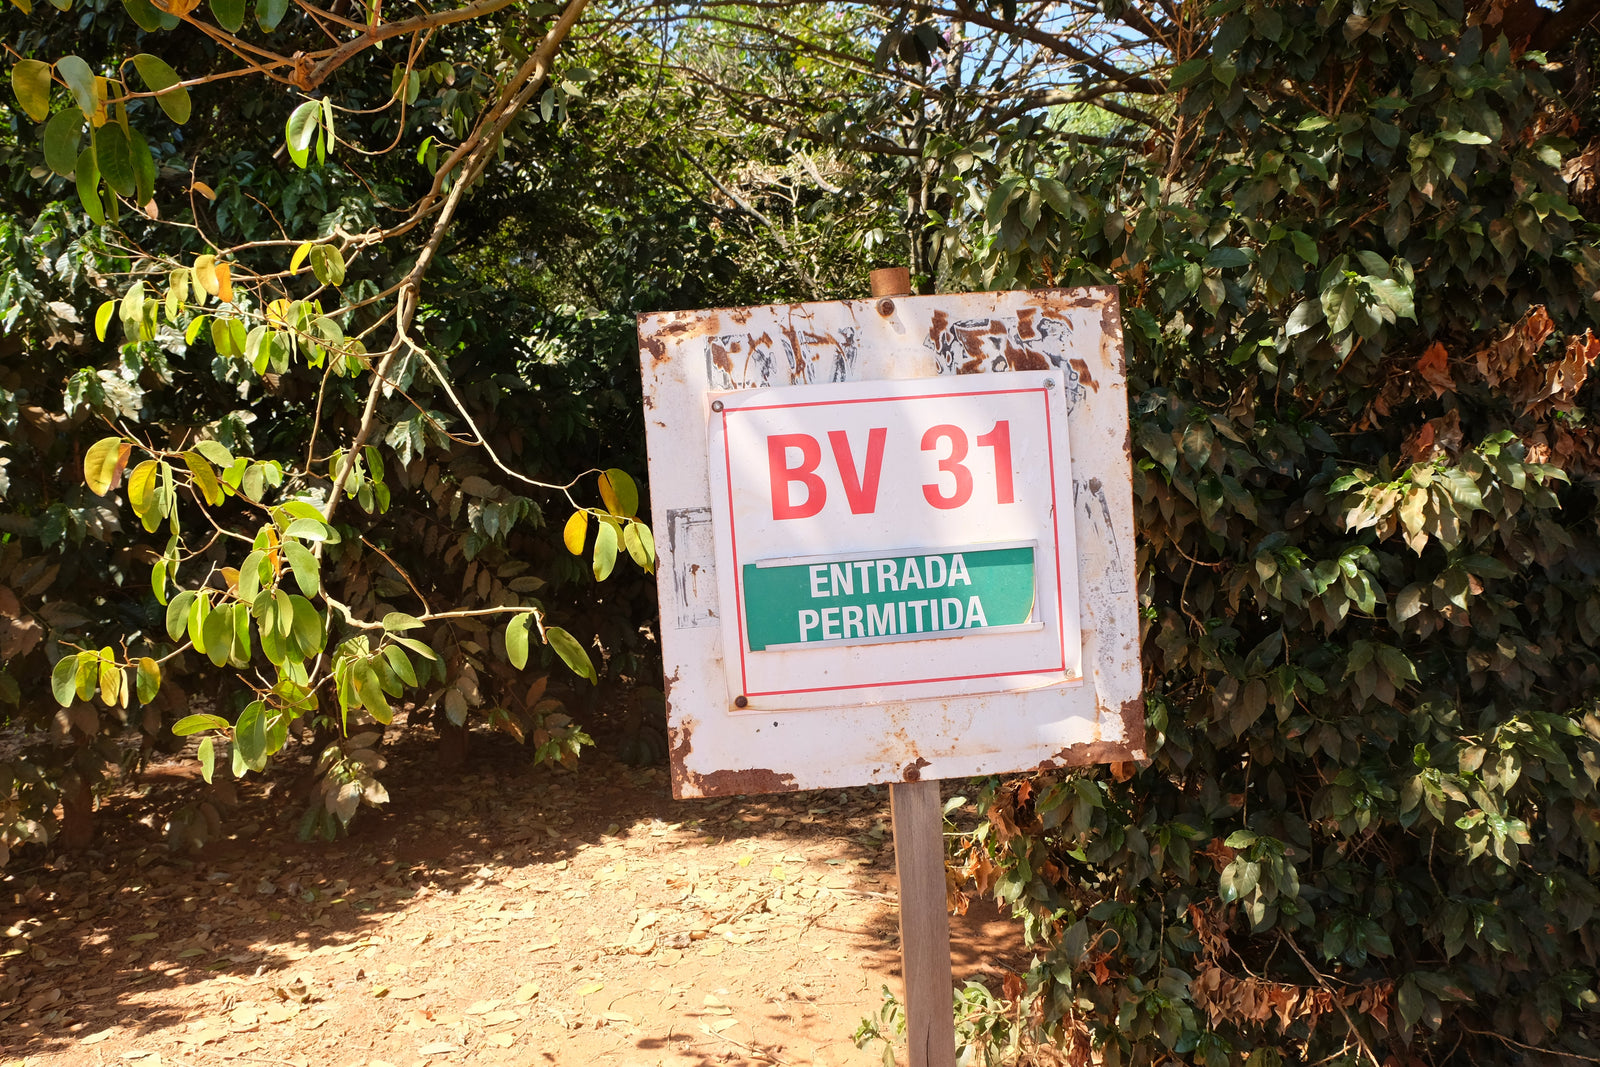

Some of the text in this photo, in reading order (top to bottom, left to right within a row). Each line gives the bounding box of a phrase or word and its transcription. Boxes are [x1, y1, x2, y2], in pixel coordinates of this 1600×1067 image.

[767, 420, 1015, 521] BV 31
[808, 554, 972, 598] ENTRADA
[798, 595, 989, 642] PERMITIDA
